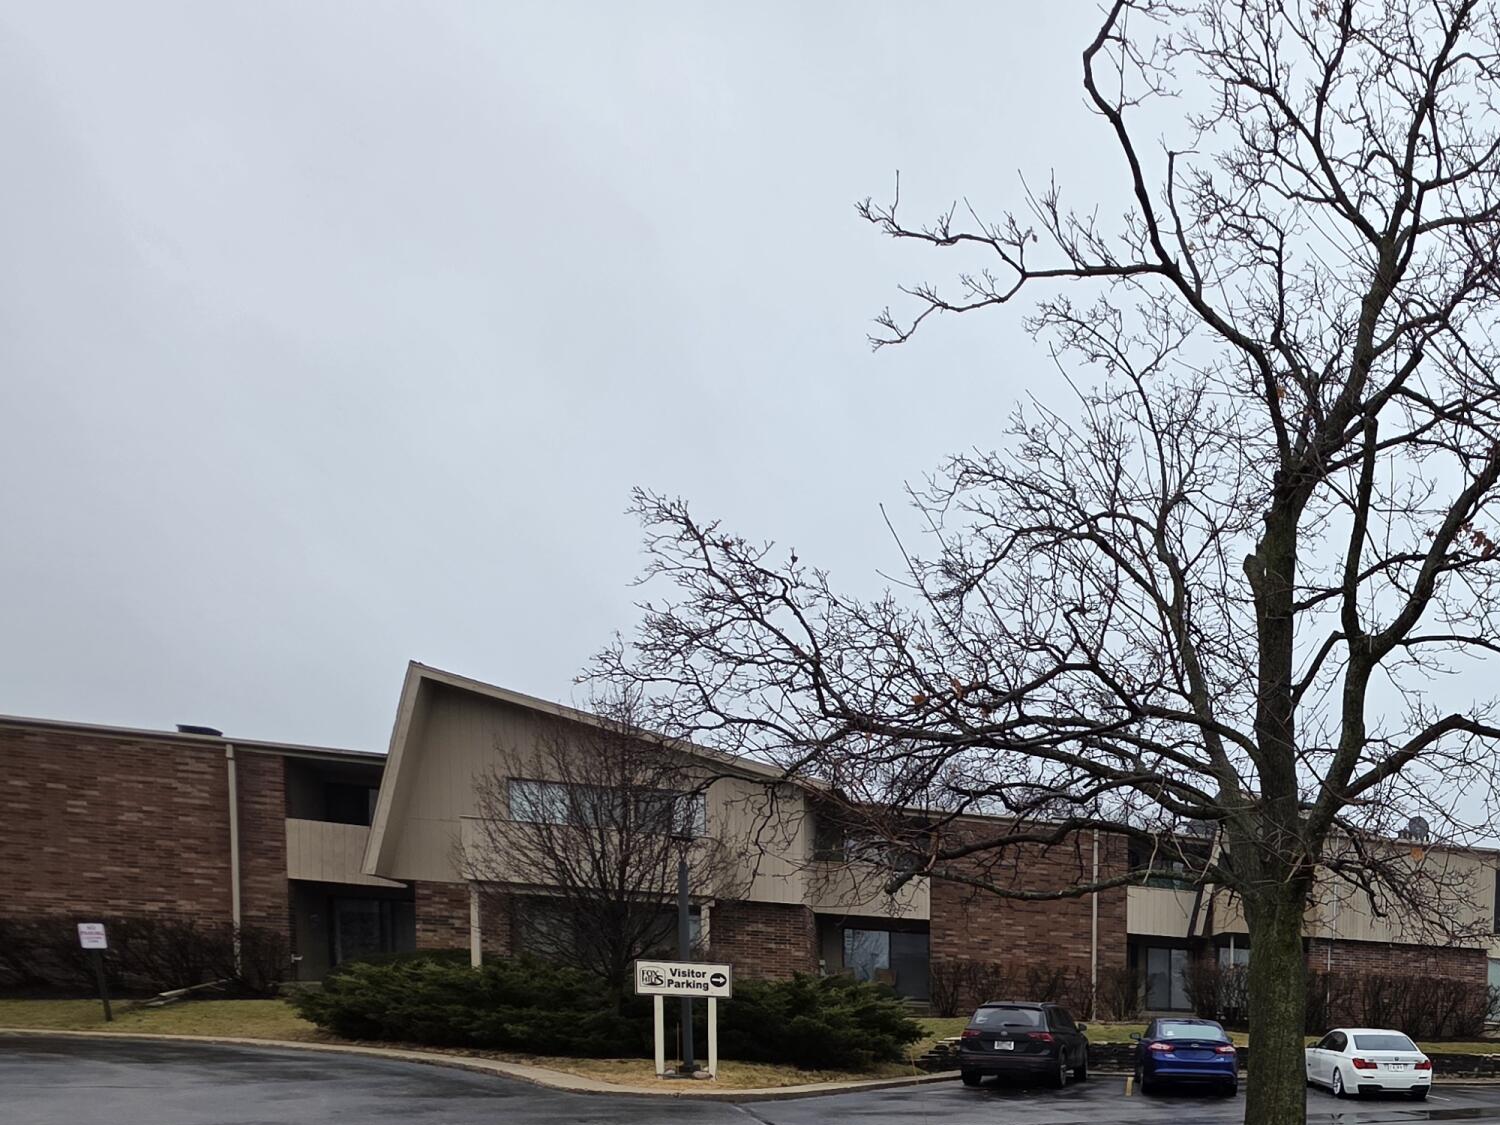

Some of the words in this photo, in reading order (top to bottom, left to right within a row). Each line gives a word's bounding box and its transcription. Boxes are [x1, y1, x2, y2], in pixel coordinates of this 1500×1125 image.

[641, 969, 659, 977] FOX
[669, 968, 707, 979] Visitor
[667, 978, 709, 992] Parking
